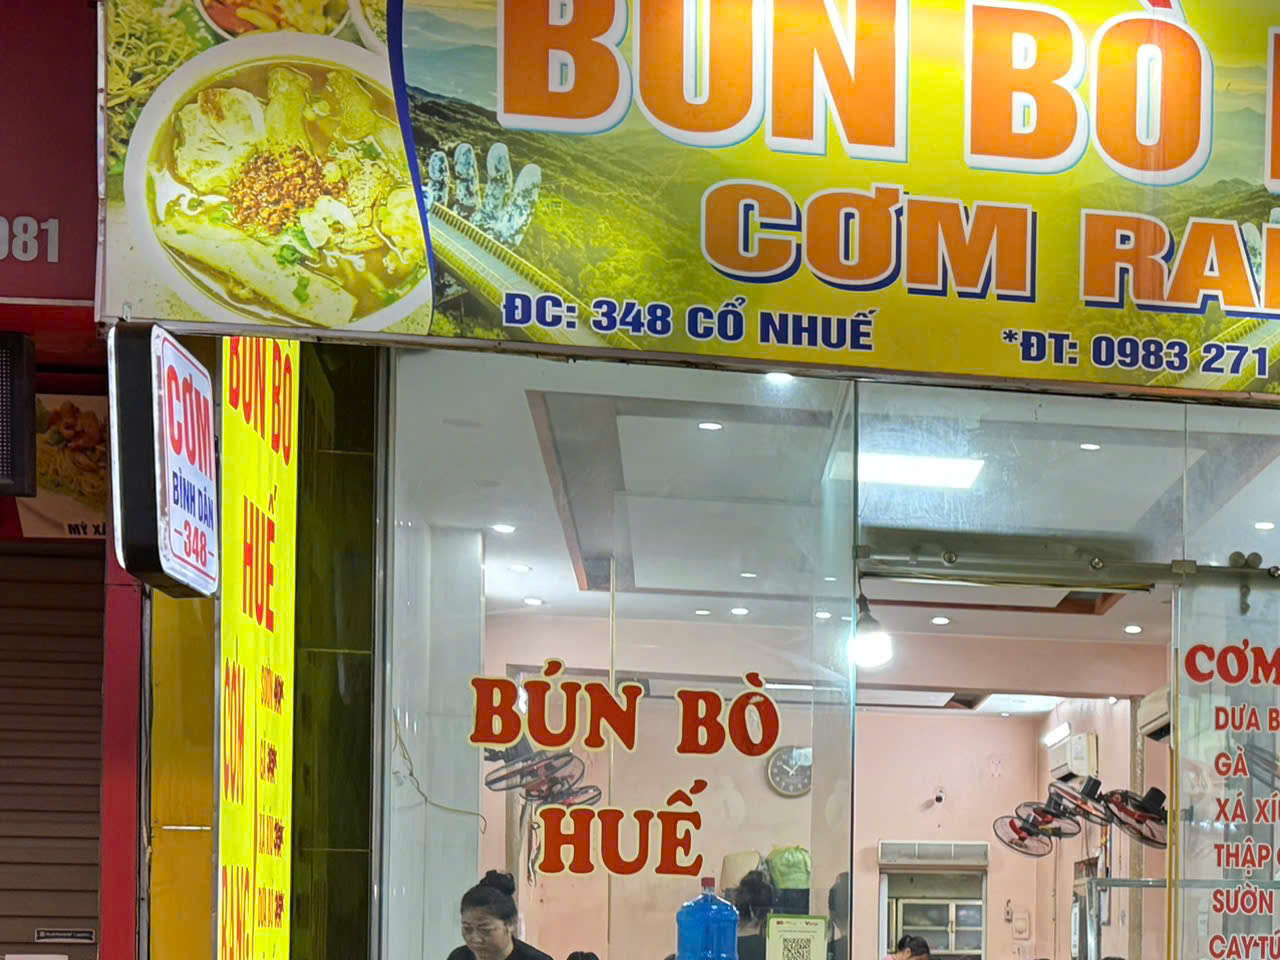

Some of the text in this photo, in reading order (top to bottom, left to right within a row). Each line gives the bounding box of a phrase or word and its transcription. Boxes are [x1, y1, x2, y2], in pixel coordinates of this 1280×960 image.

[964, 0, 1214, 185] BÒ
[702, 179, 1038, 303] CƠM
[502, 292, 578, 330] ĐC:
[591, 299, 672, 337] 348
[686, 295, 747, 343] CỔ
[758, 308, 879, 352] NHUẾ
[1091, 334, 1189, 373] 0983
[1200, 341, 1268, 378] 271
[166, 364, 214, 481] CƠM
[172, 469, 214, 531] BÌNH DÂN
[243, 485, 278, 633] HUẾ
[223, 635, 246, 806] CƠM
[468, 657, 782, 758] BÚN BÒ
[1214, 704, 1261, 731] DƯA
[1214, 745, 1249, 777] GÀ
[536, 778, 711, 877] HUẾ
[1215, 792, 1249, 823] XÁ
[1212, 883, 1274, 914] SƯỜN
[1213, 836, 1273, 877] THẬP
